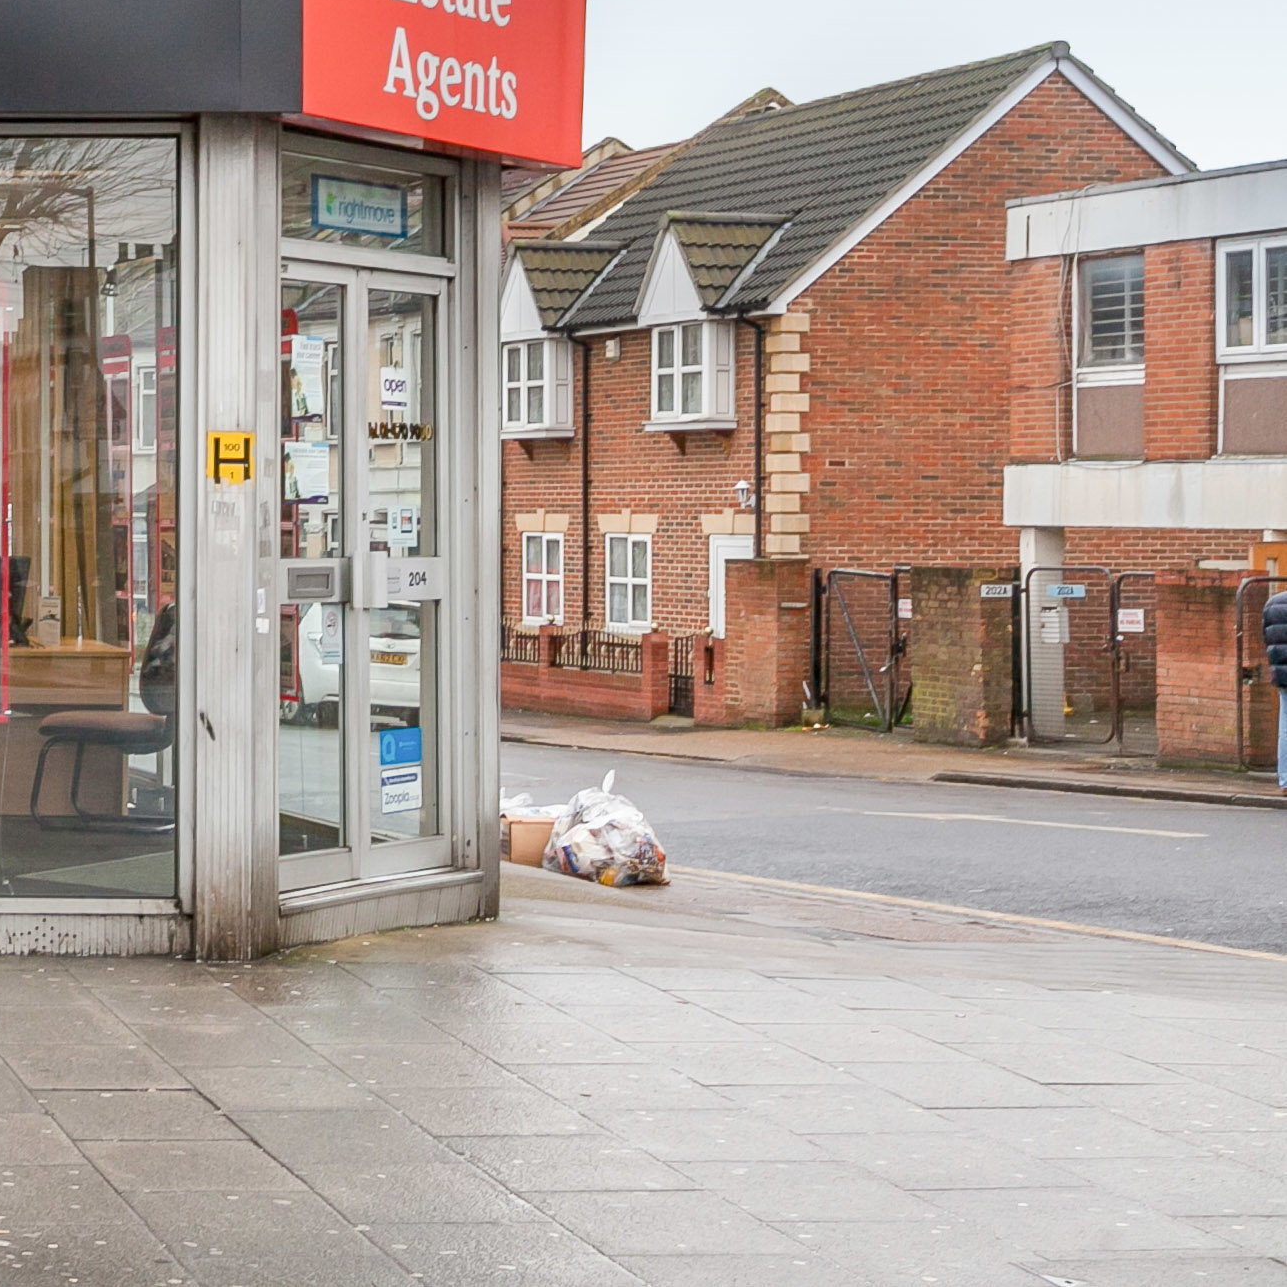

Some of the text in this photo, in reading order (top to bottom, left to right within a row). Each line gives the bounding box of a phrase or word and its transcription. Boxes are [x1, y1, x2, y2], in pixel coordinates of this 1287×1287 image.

[383, 26, 518, 121] Agents
[338, 197, 395, 223] rightmove
[384, 376, 407, 396] open
[224, 444, 241, 452] 100
[409, 571, 427, 587] 204
[985, 587, 1007, 595] 202A
